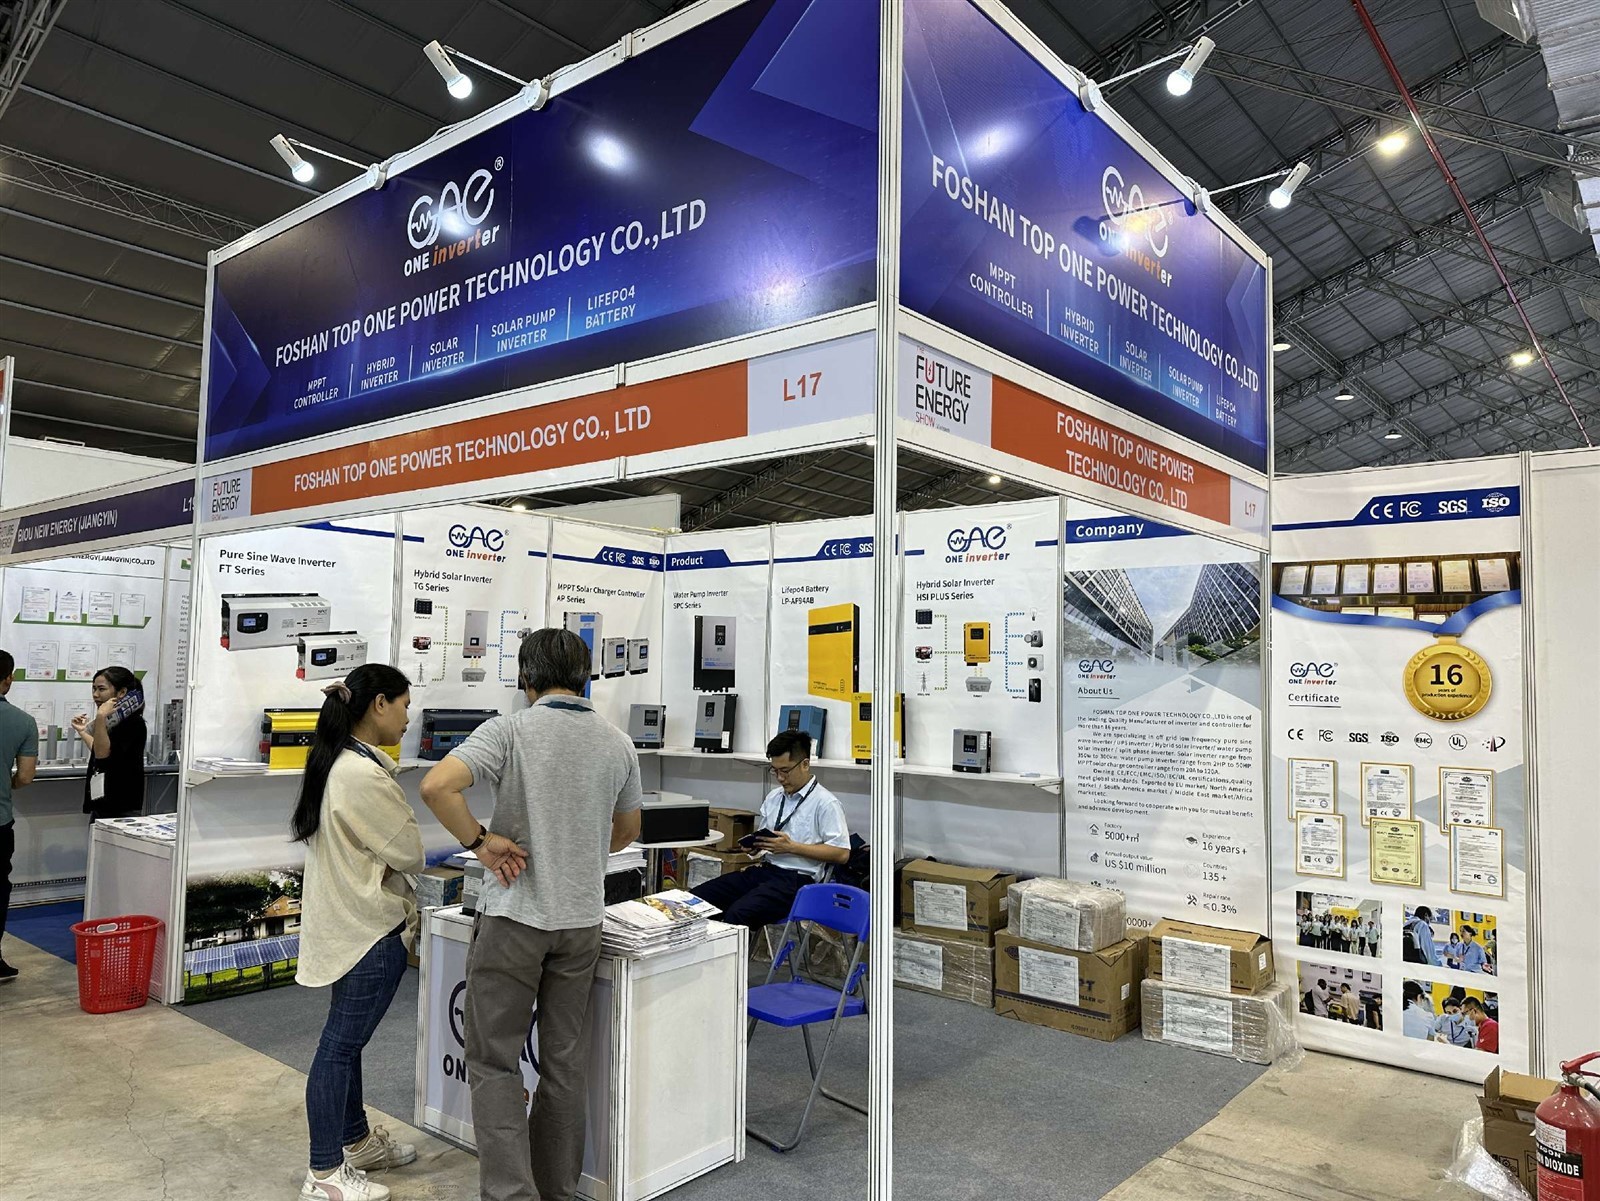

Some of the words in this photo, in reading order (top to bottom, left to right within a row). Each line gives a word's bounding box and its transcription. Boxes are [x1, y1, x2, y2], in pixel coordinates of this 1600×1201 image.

[404, 252, 430, 277] ONE
[433, 225, 500, 266] inverter
[932, 154, 1014, 238] FOSHAN
[1019, 214, 1055, 260] TOP
[1058, 243, 1093, 288] ONE
[1097, 265, 1148, 321] POWER
[1151, 301, 1223, 370] TECHNOLOGY
[1224, 353, 1259, 392] CO.,LTD
[989, 262, 1016, 289] MPPT
[275, 330, 328, 367] FOSHAN
[332, 319, 360, 348] TOP
[363, 306, 396, 337] ONE
[400, 283, 460, 325] POWER
[465, 231, 605, 302] TECHNOLOGY
[610, 199, 707, 255] CO.,LTD
[587, 285, 635, 310] LIFEPO4
[969, 273, 1033, 319] CONTROLLER
[491, 316, 523, 337] SOLAR
[525, 307, 556, 328] PUMP
[585, 303, 636, 329] BATTERY
[1065, 306, 1095, 333] HYBRID
[429, 336, 458, 355] SOLAR
[497, 328, 547, 352] INVERTER
[1060, 322, 1099, 355] INVERTER
[1125, 341, 1148, 363] SOLAR
[366, 356, 395, 374] HYBRID
[422, 351, 464, 373] INVERTER
[1119, 354, 1152, 382] INVERTER
[307, 376, 327, 392] MPPT
[361, 371, 398, 390] INVERTER
[916, 355, 971, 399] FUTURE
[1168, 365, 1187, 386] SOLAR
[1187, 376, 1204, 394] PUMP
[783, 372, 823, 403] L17
[1172, 384, 1200, 408] INVERTER
[294, 388, 338, 409] CONTROLLER
[915, 383, 969, 425] ENERGY
[1215, 408, 1237, 428] BATTERY
[294, 466, 340, 492] FOSHAN
[343, 462, 367, 483] TOP
[369, 456, 397, 478] ONE
[400, 445, 452, 473] POWER
[455, 421, 569, 463] TECHNOLOGY
[573, 415, 610, 442] CO.,
[615, 405, 651, 434] LTD
[1056, 411, 1108, 451] FOSHAN
[1111, 432, 1134, 460] TOP
[1135, 444, 1158, 470] ONE
[1160, 453, 1194, 485] POWER
[213, 478, 241, 497] FUTURE
[1066, 450, 1147, 497] TECHNOLOGY
[1149, 479, 1169, 507] CO.,
[1170, 487, 1188, 510] LTD
[211, 495, 240, 513] ENERGY
[1244, 500, 1257, 519] L17
[1369, 502, 1394, 520] CE
[1438, 499, 1468, 514] SGS
[1482, 495, 1510, 510] ISO
[34, 522, 49, 539] NEW
[49, 516, 78, 536] ENERGY
[78, 509, 118, 534] (JIANGYIN)
[1075, 523, 1144, 538] Company
[445, 548, 464, 558] ONE
[466, 550, 506, 563] inverter
[859, 542, 873, 554] SGS
[945, 555, 963, 563] ONE
[965, 551, 1010, 563] inverter
[219, 549, 244, 560] Pure
[246, 551, 268, 562] Sine
[270, 553, 296, 565] Wave
[298, 556, 336, 568] Inverter
[632, 555, 645, 565] SGS
[671, 556, 704, 567] Product
[219, 564, 232, 574] FT
[234, 565, 265, 576] Series
[414, 569, 440, 580] Hybrid
[441, 571, 462, 581] Solar
[463, 573, 493, 584] Inverter
[414, 582, 424, 591] TG
[425, 582, 450, 593] Series
[557, 583, 575, 592] MPPT
[576, 584, 592, 593] Solar
[593, 586, 617, 597] Charger
[617, 588, 646, 598] Controller
[781, 586, 804, 595] Lifepo4
[805, 585, 829, 594] Battery
[916, 580, 941, 590] Hybrid
[942, 579, 962, 588] Solar
[963, 578, 995, 587] Inverter
[567, 595, 586, 604] Series
[673, 591, 688, 599] Water
[690, 591, 705, 600] Pump
[916, 593, 929, 601] HSI
[930, 592, 949, 601] PLUS
[950, 592, 974, 600] Series
[673, 602, 684, 610] SPC
[685, 601, 701, 609] Series
[1304, 678, 1337, 686] inverter
[1430, 664, 1463, 685] 16
[1077, 686, 1102, 695] About
[1102, 687, 1113, 695] Us
[1288, 693, 1340, 703] Certificate
[1163, 711, 1201, 719] TECHNOLOGY
[1287, 728, 1304, 741] CE
[1349, 732, 1369, 744] SGS
[1380, 734, 1400, 744] ISO
[1202, 832, 1231, 840] Experience
[1202, 841, 1213, 851] 16
[1215, 844, 1240, 855] years
[1104, 859, 1117, 869] US
[1118, 860, 1134, 871] $10
[1136, 863, 1167, 875] million
[1202, 862, 1228, 871] Countries
[1202, 871, 1219, 882] 135
[1544, 1155, 1580, 1176] DIOXIDE
